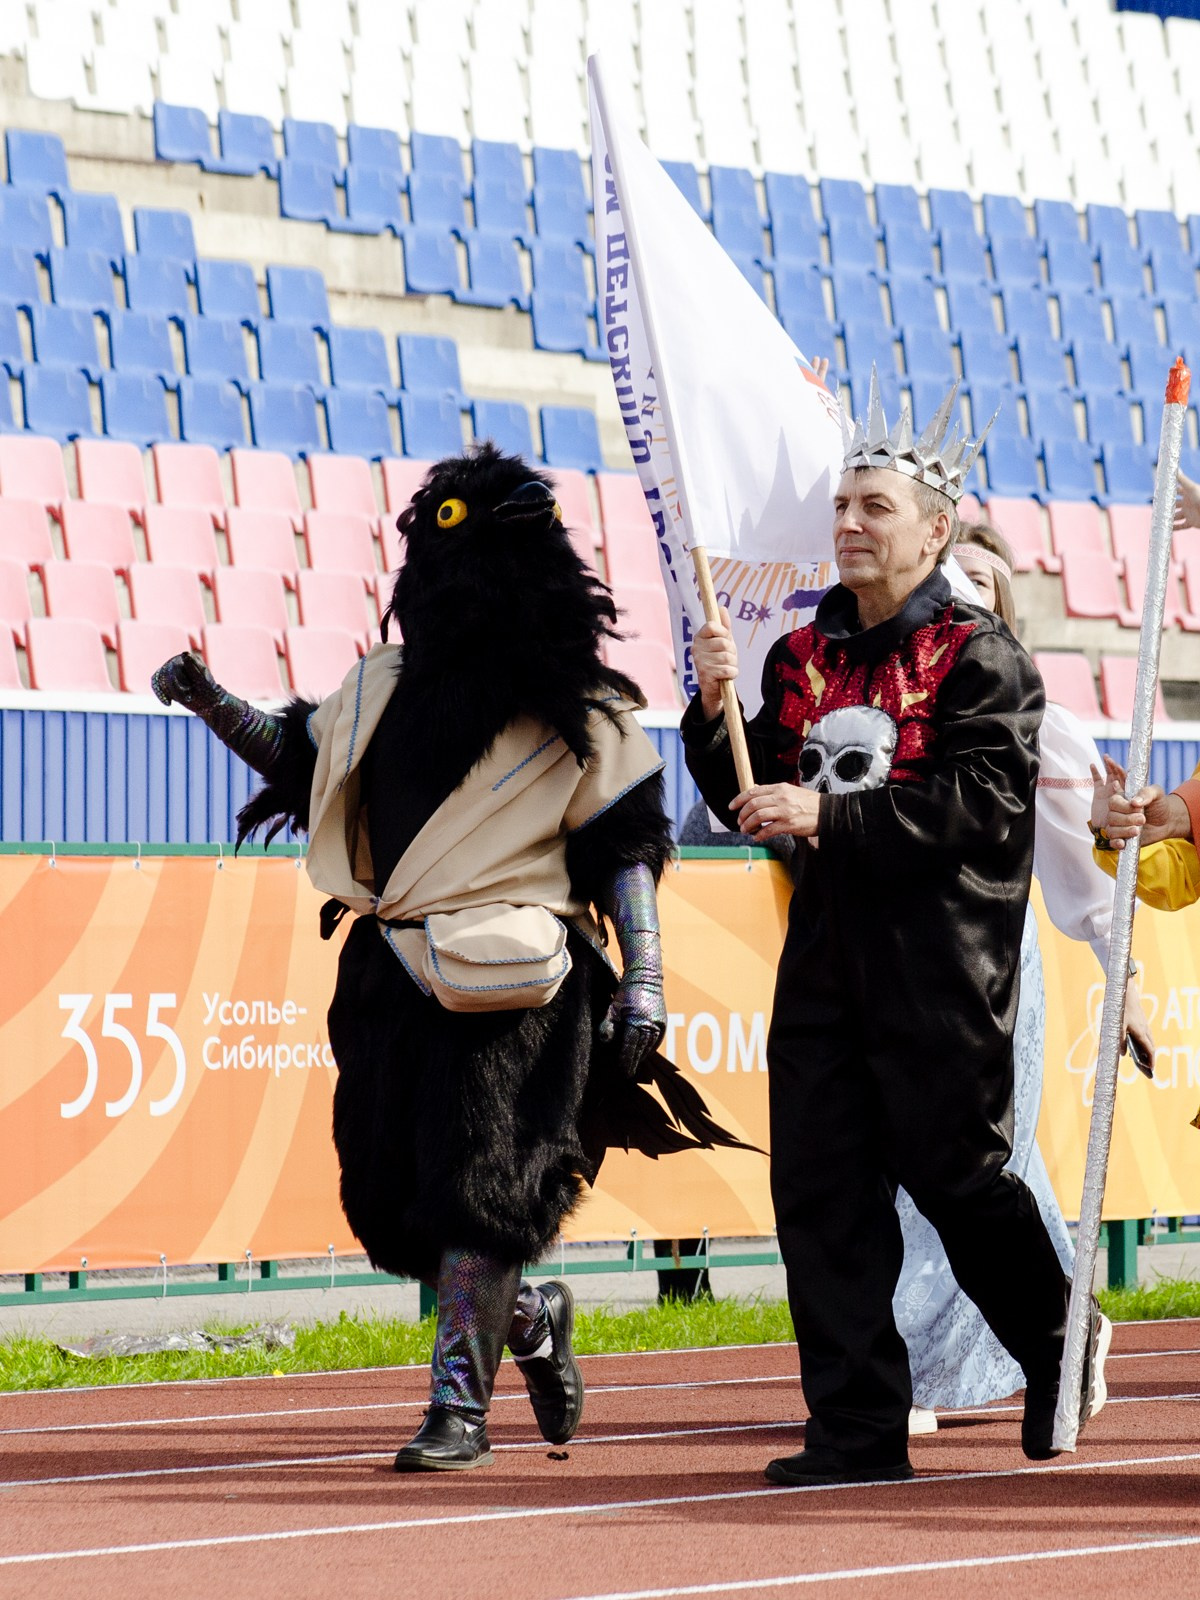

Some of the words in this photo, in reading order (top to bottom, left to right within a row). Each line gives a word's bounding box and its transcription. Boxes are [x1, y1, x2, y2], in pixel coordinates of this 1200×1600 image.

[201, 991, 308, 1026] Усолье-
[58, 992, 187, 1119] 355
[201, 1034, 338, 1078] Сибирско
[665, 1011, 769, 1075] ТОМ
